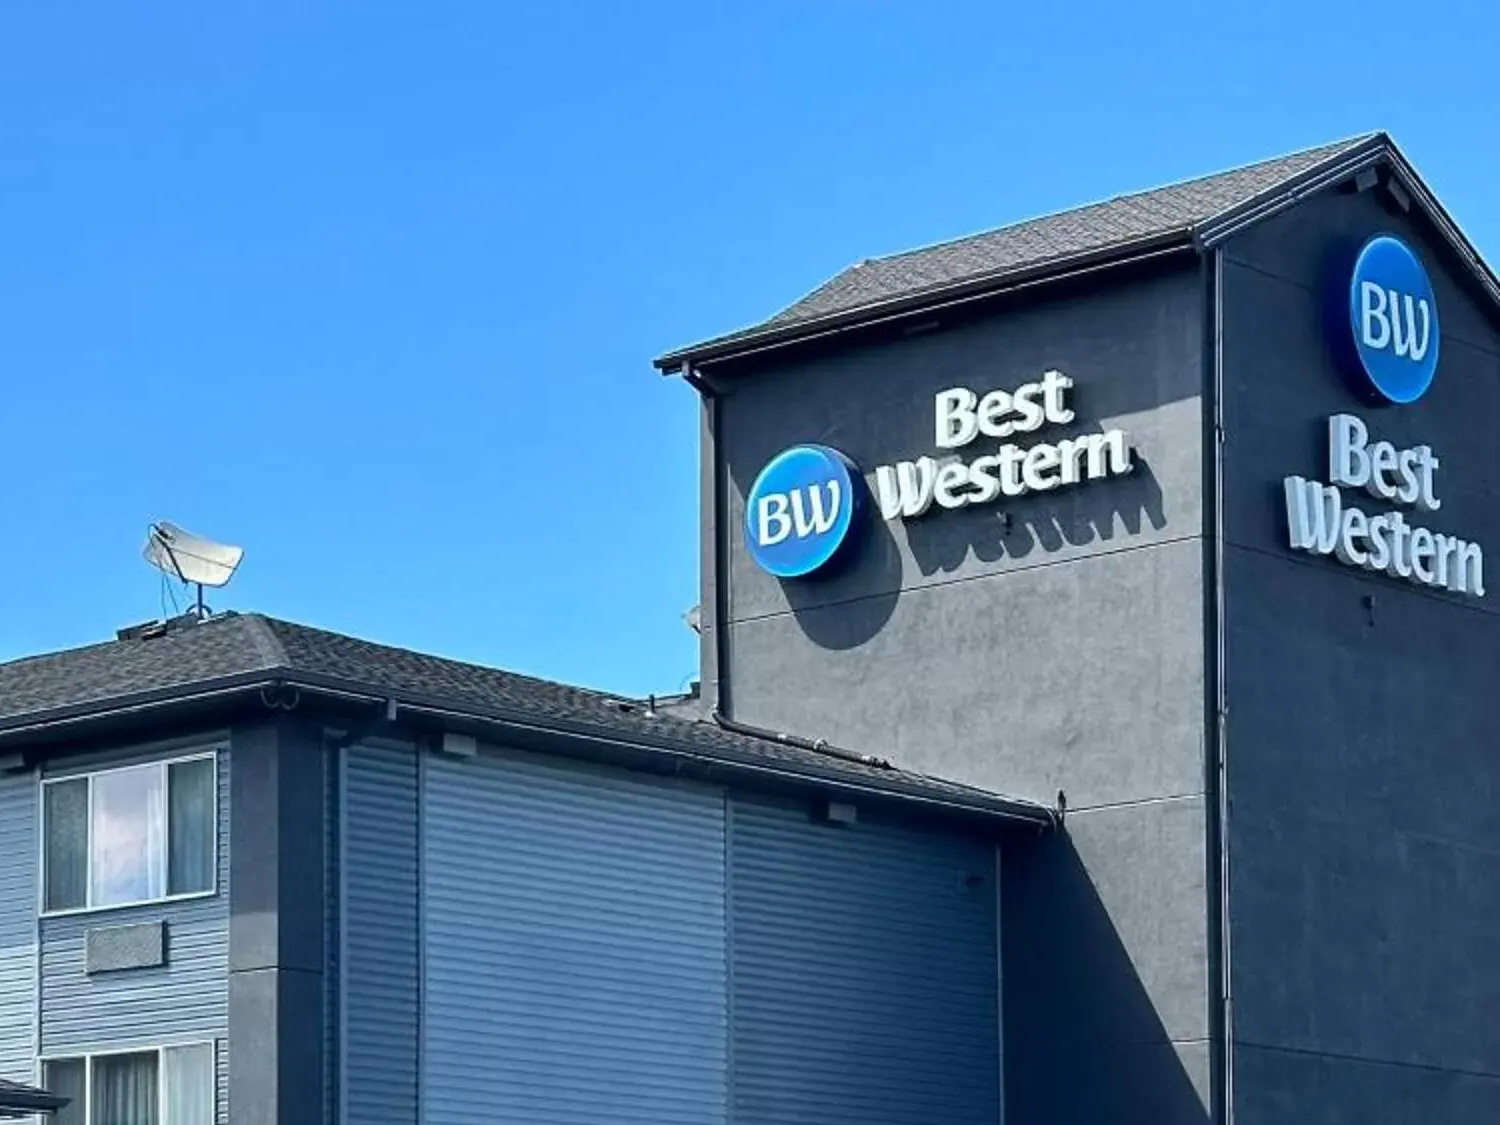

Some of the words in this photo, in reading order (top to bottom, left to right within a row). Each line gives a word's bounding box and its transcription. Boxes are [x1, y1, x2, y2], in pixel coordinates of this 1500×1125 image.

[1361, 281, 1430, 362] BW
[934, 369, 1075, 449] Best
[875, 429, 1134, 521] Western
[1329, 413, 1441, 511] Best
[756, 479, 841, 547] BW
[1284, 475, 1485, 597] Western
